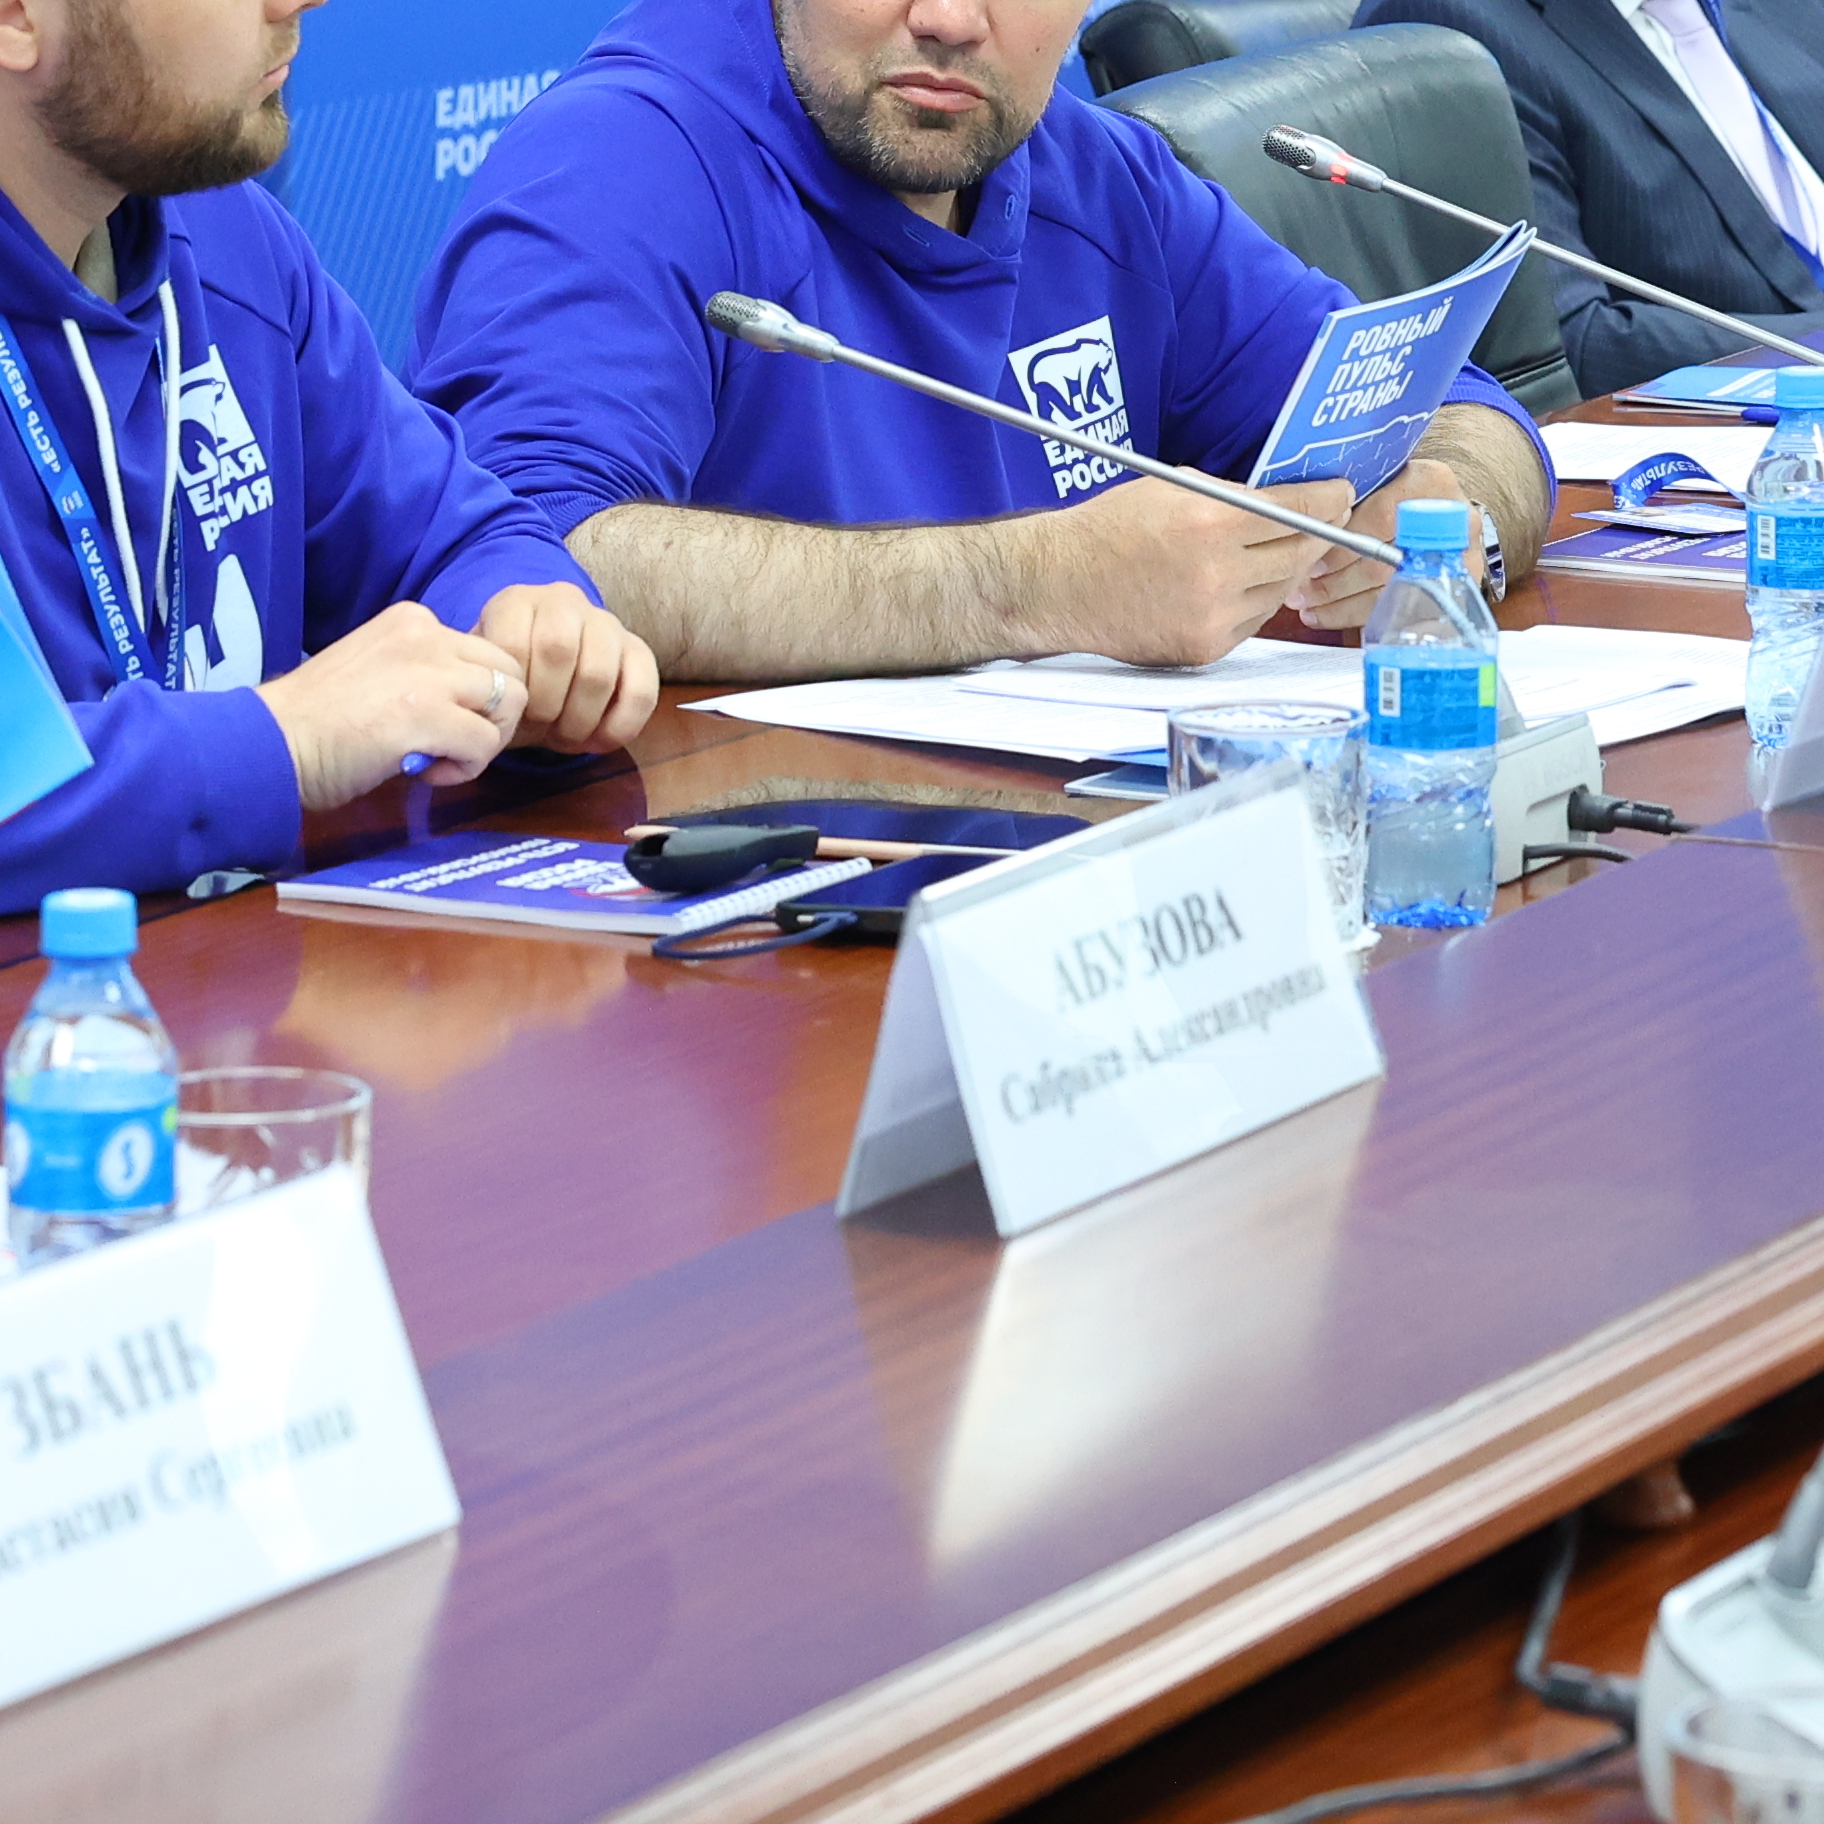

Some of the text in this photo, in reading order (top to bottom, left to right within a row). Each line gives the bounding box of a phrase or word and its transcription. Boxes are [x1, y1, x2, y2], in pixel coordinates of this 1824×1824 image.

[1341, 296, 1454, 361] РОВНЫЙ
[1311, 370, 1414, 427] СТРАНЫ
[1326, 345, 1413, 394] ПУЛЬС
[80, 525, 140, 659] РЕЗУЛЬТАТ»
[1052, 885, 1244, 1014] АБУЗОВА
